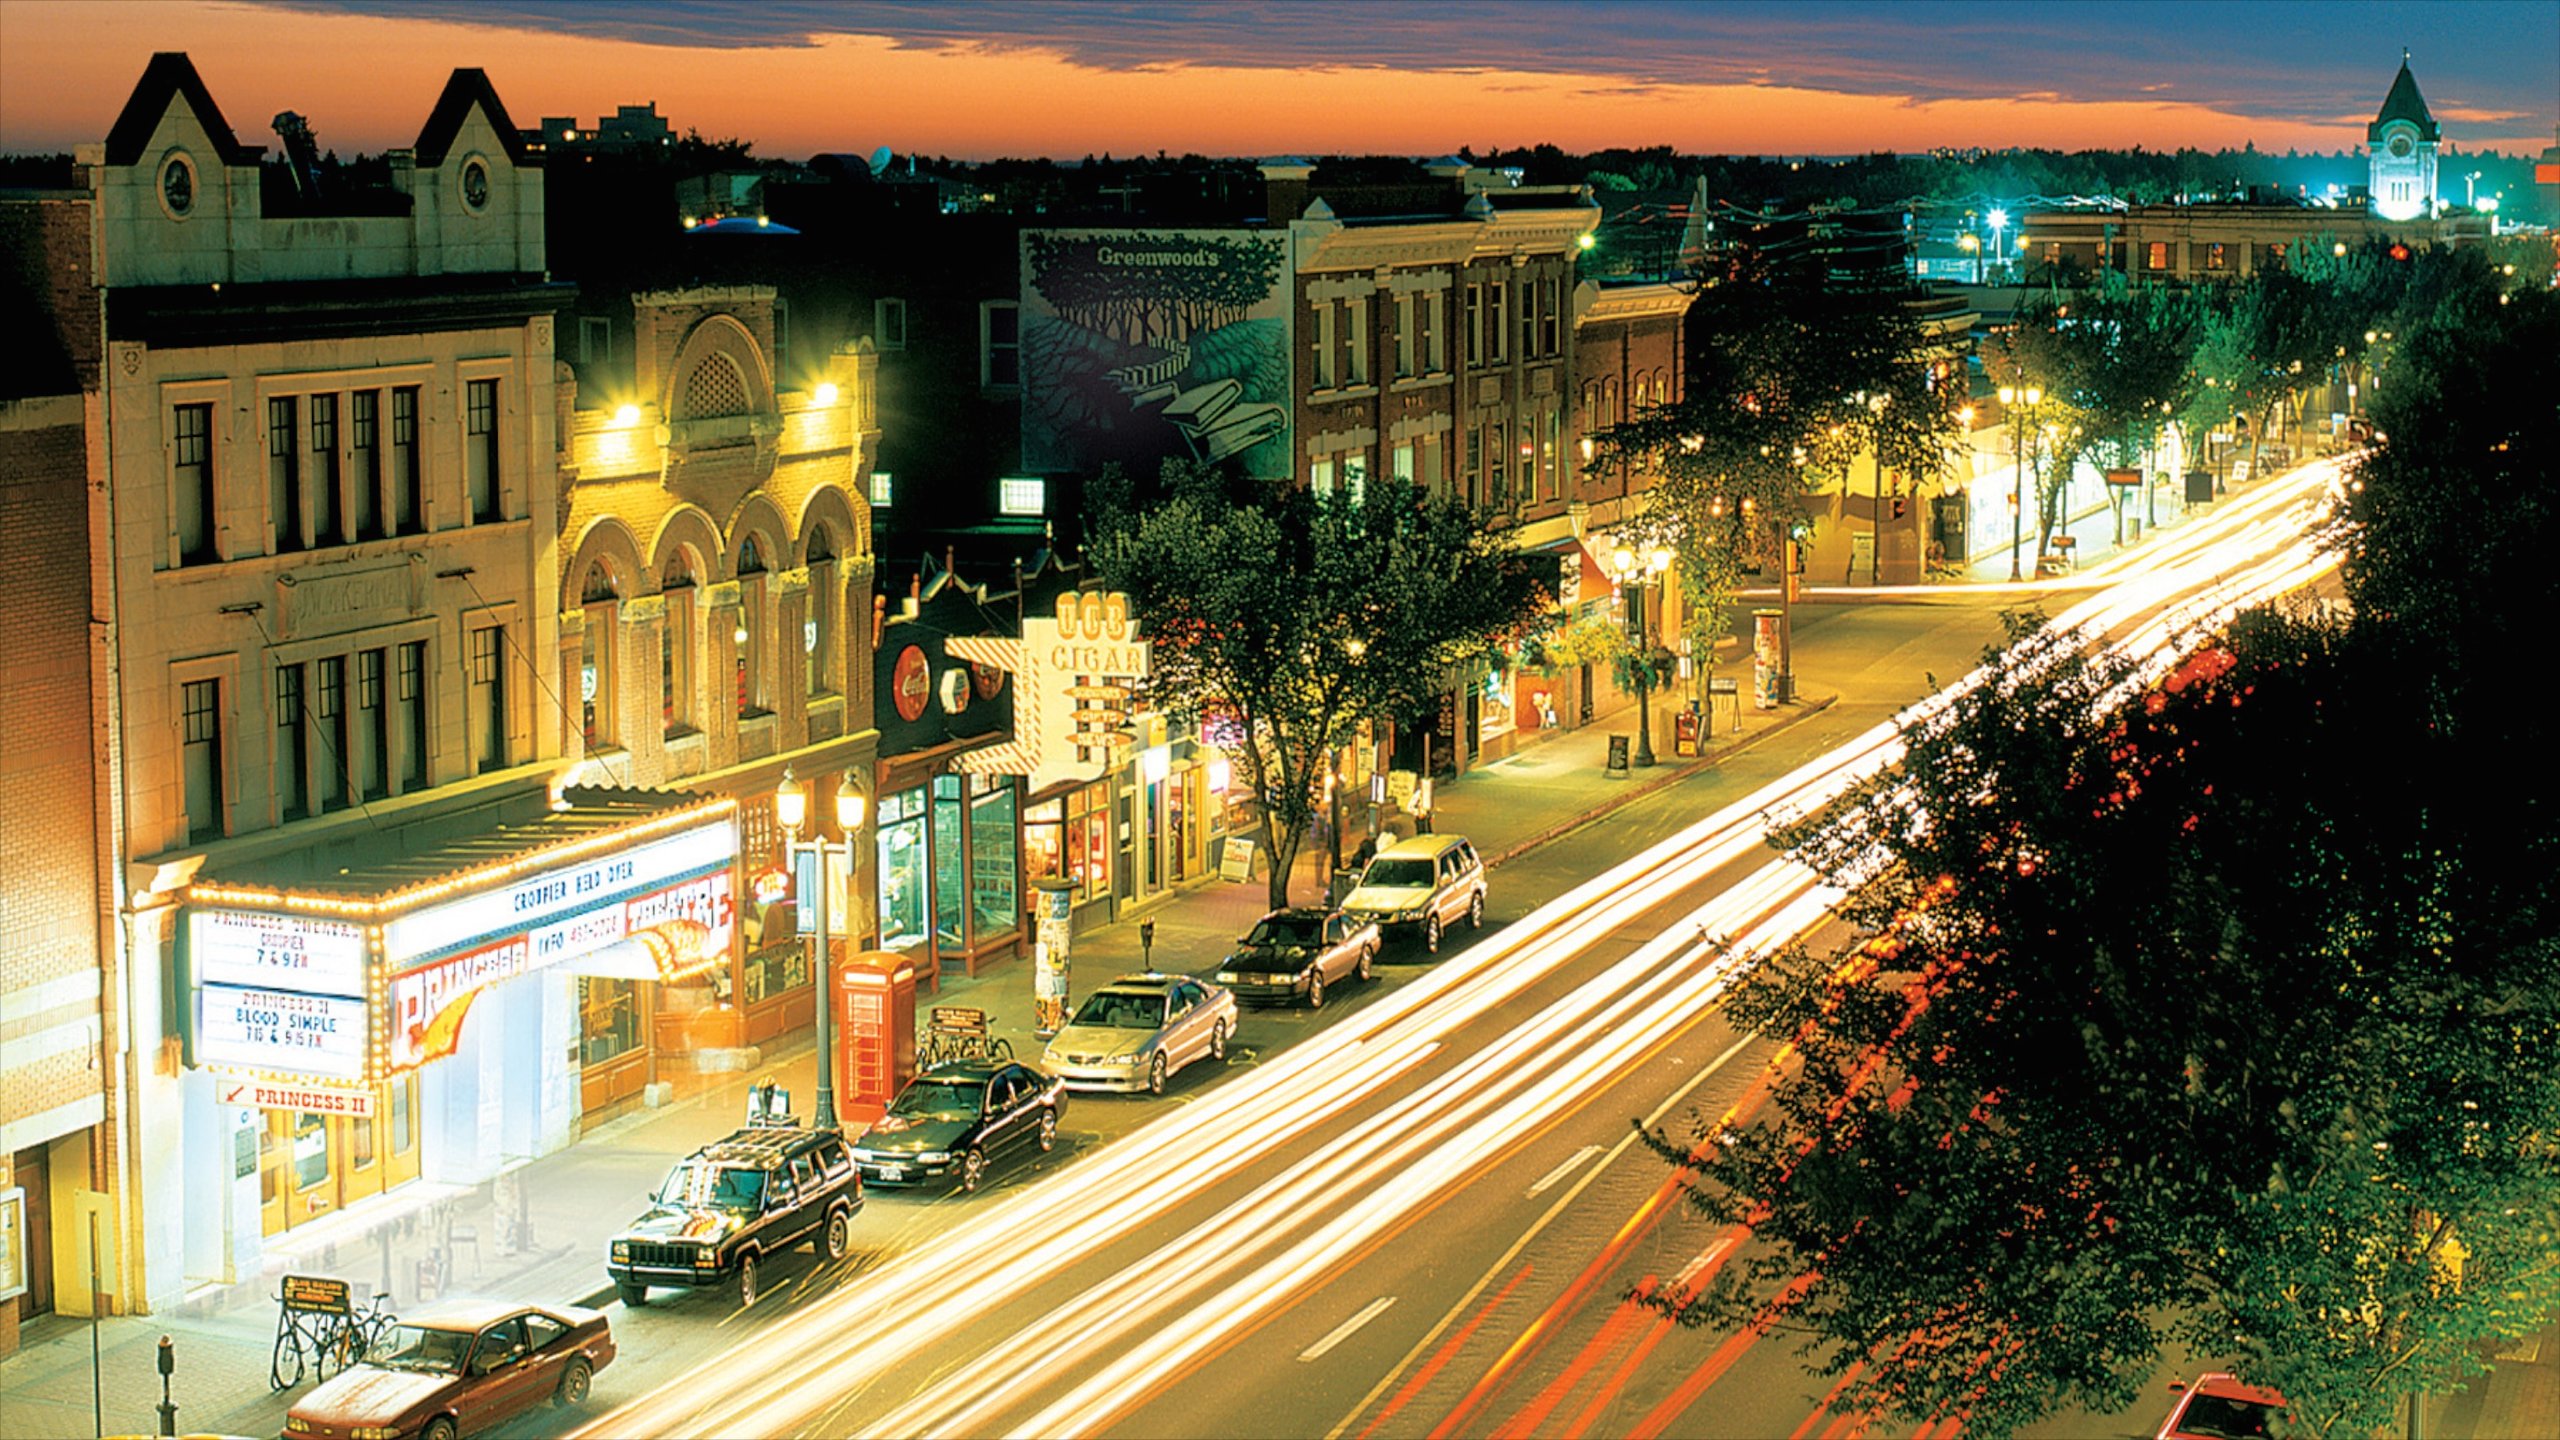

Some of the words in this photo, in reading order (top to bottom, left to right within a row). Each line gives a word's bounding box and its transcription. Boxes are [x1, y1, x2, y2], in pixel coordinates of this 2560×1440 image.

[1097, 246, 1220, 267] Greenwood's
[1051, 646, 1142, 674] CIGAR
[1077, 732, 1117, 746] NEWS
[514, 881, 567, 912] CROUPIER
[627, 872, 733, 953] THEATRE
[392, 942, 527, 1067] PRINCESS
[236, 1007, 280, 1027] BLOOD
[290, 1013, 337, 1033] SIMPLE
[255, 1087, 346, 1112] PRINCESS
[352, 1097, 366, 1113] II
